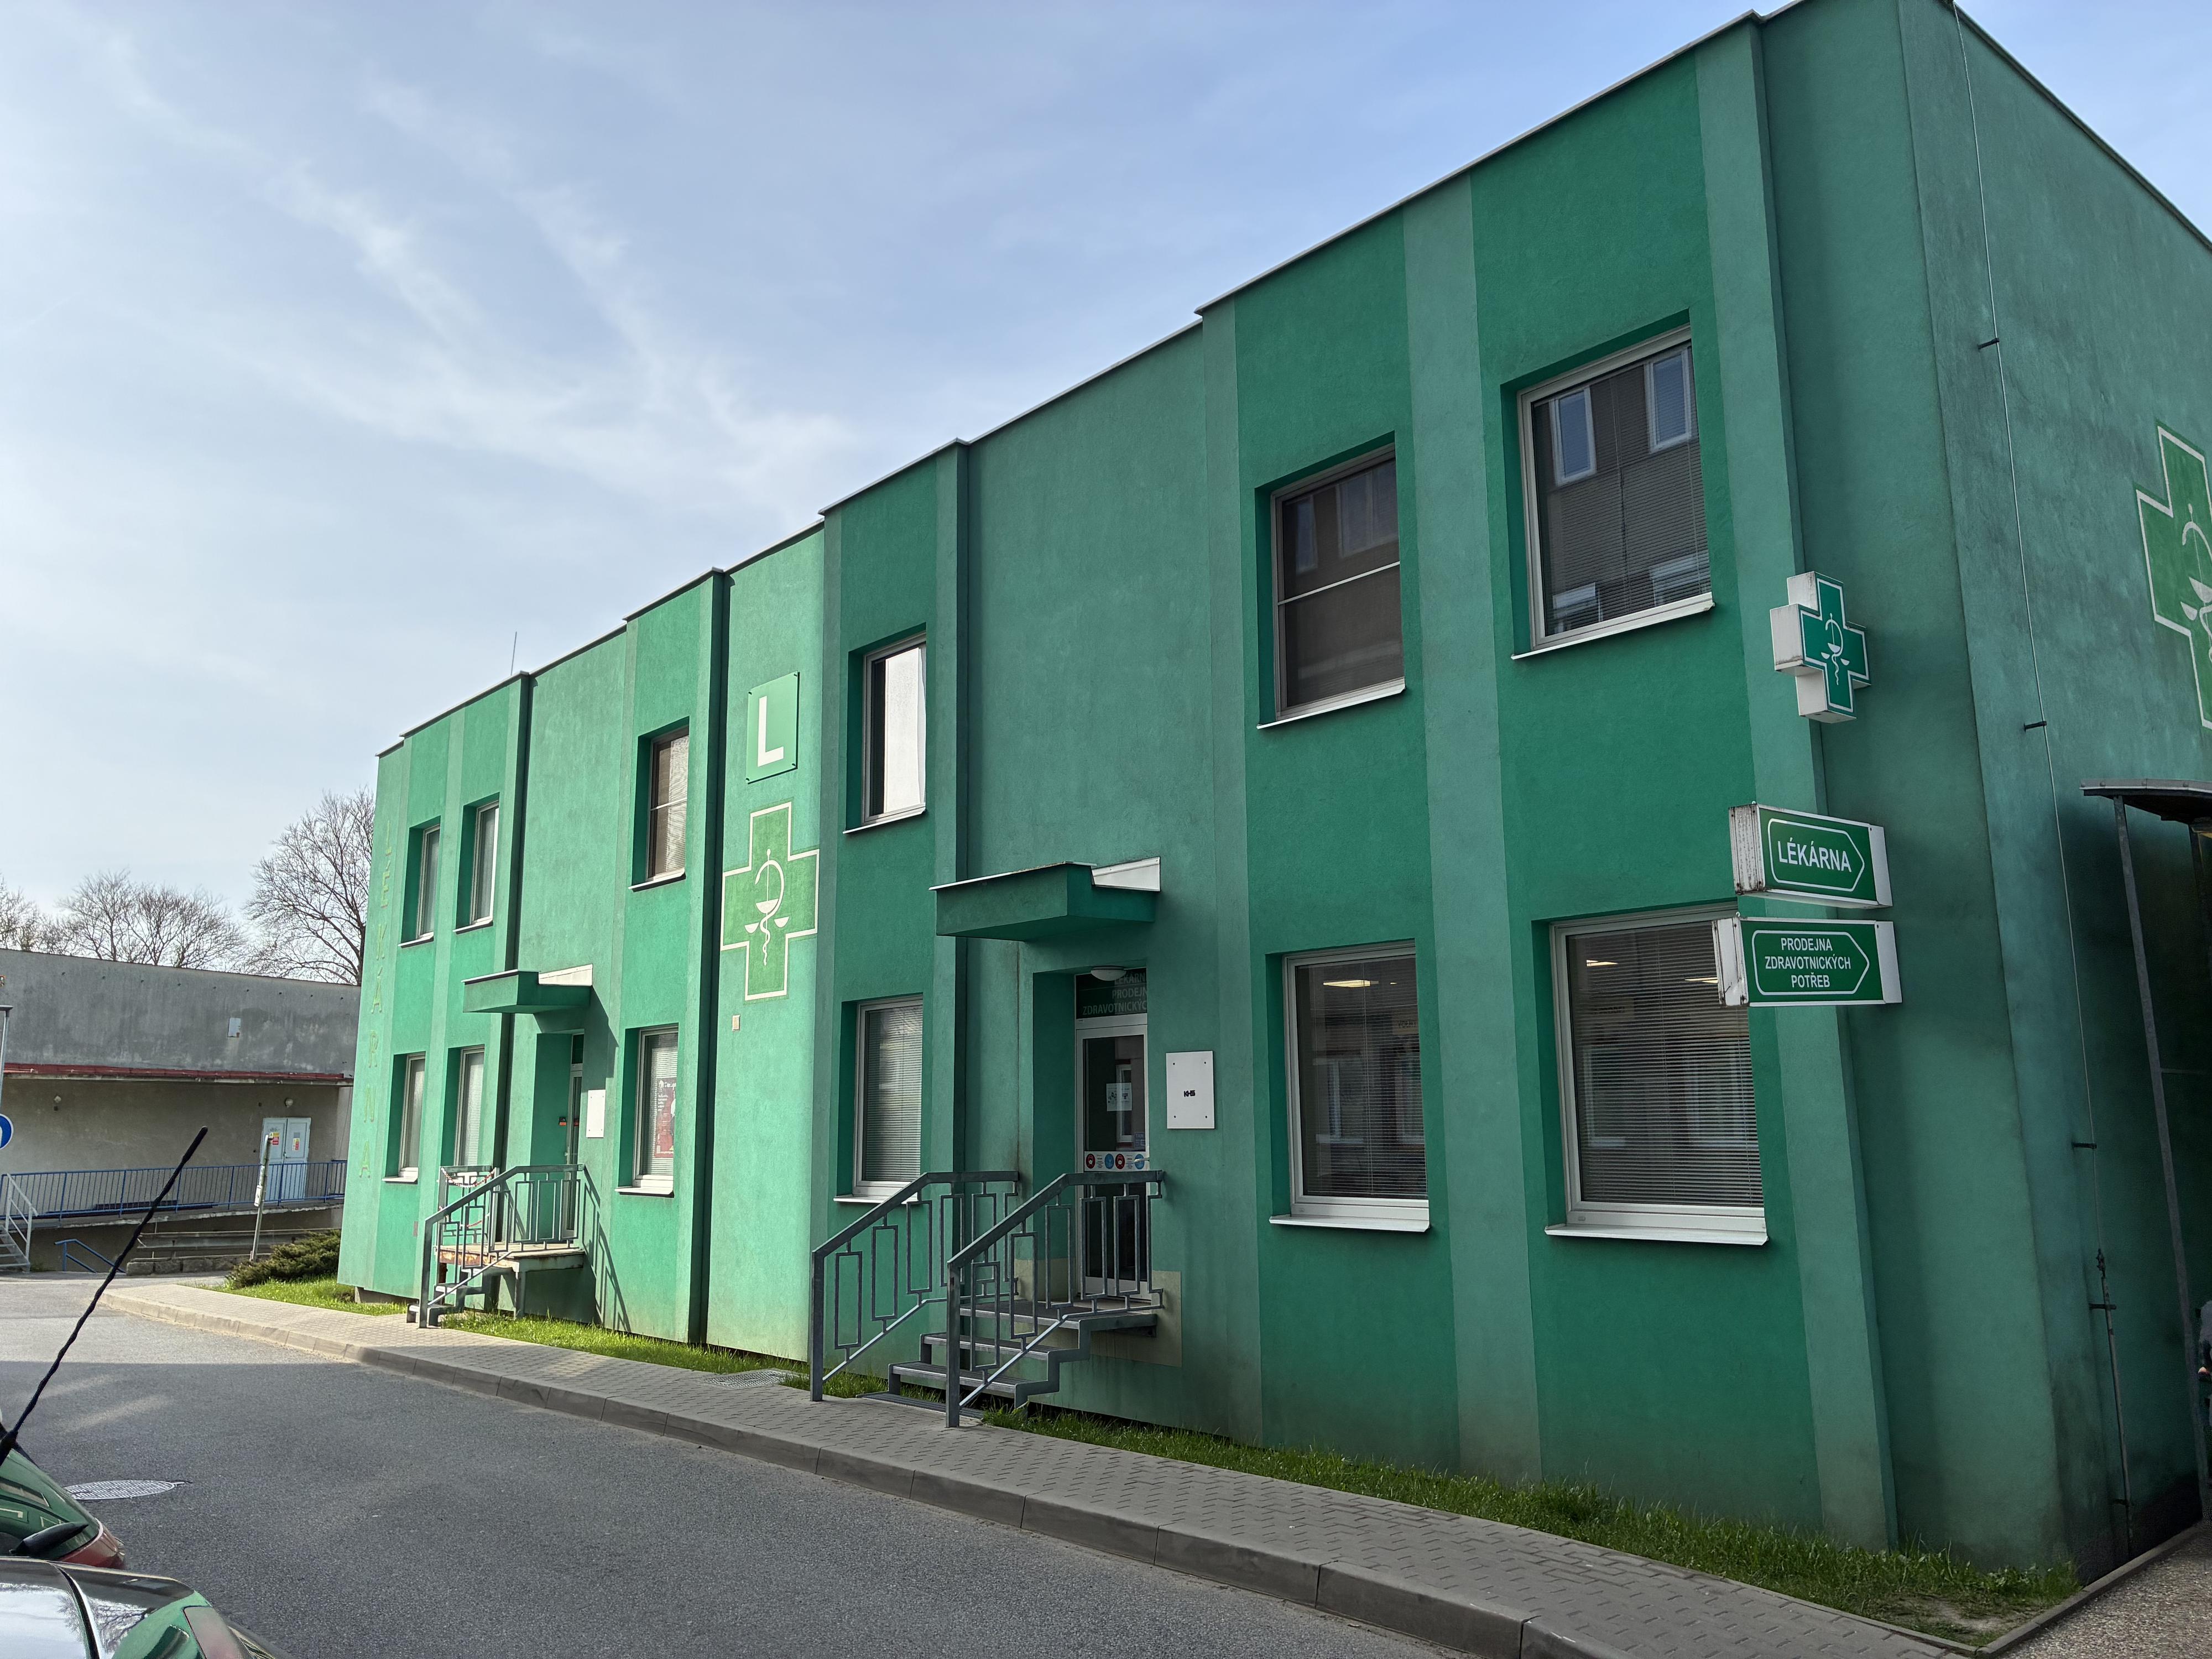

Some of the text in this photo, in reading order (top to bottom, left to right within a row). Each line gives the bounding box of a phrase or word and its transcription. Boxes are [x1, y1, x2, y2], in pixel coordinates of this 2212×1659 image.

[758, 696, 784, 767] L
[1778, 837, 1852, 872] LÉKÁRNA
[1781, 938, 1833, 951] PRODEJNA
[1765, 954, 1851, 969] ZDRAVOTNICKÝCH
[1791, 972, 1830, 988] POTŘEB
